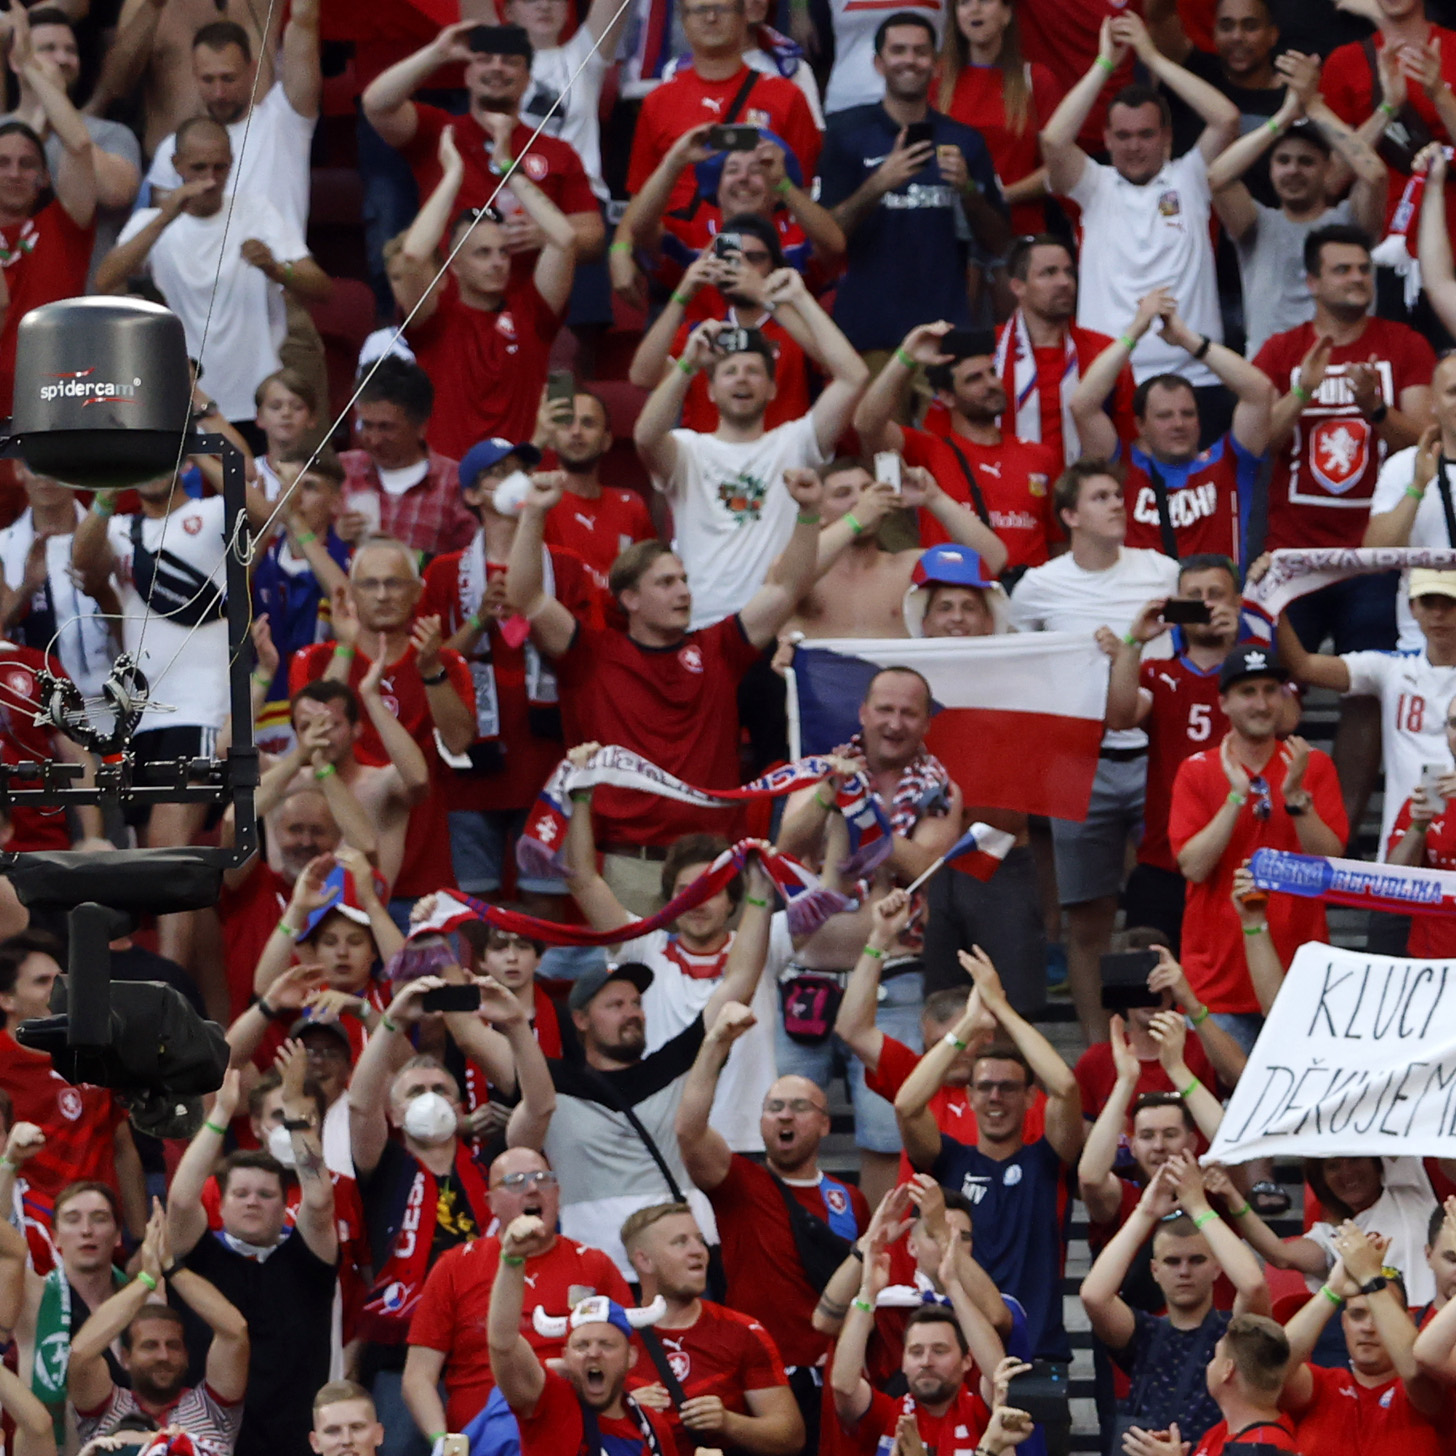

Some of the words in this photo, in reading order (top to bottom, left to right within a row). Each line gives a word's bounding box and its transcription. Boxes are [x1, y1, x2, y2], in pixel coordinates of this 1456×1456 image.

[40, 379, 135, 404] spidercam
[1186, 703, 1213, 742] 5
[1396, 694, 1425, 733] 18
[1330, 864, 1444, 906] REPUBLIKA
[1307, 961, 1451, 1042] KLUCI
